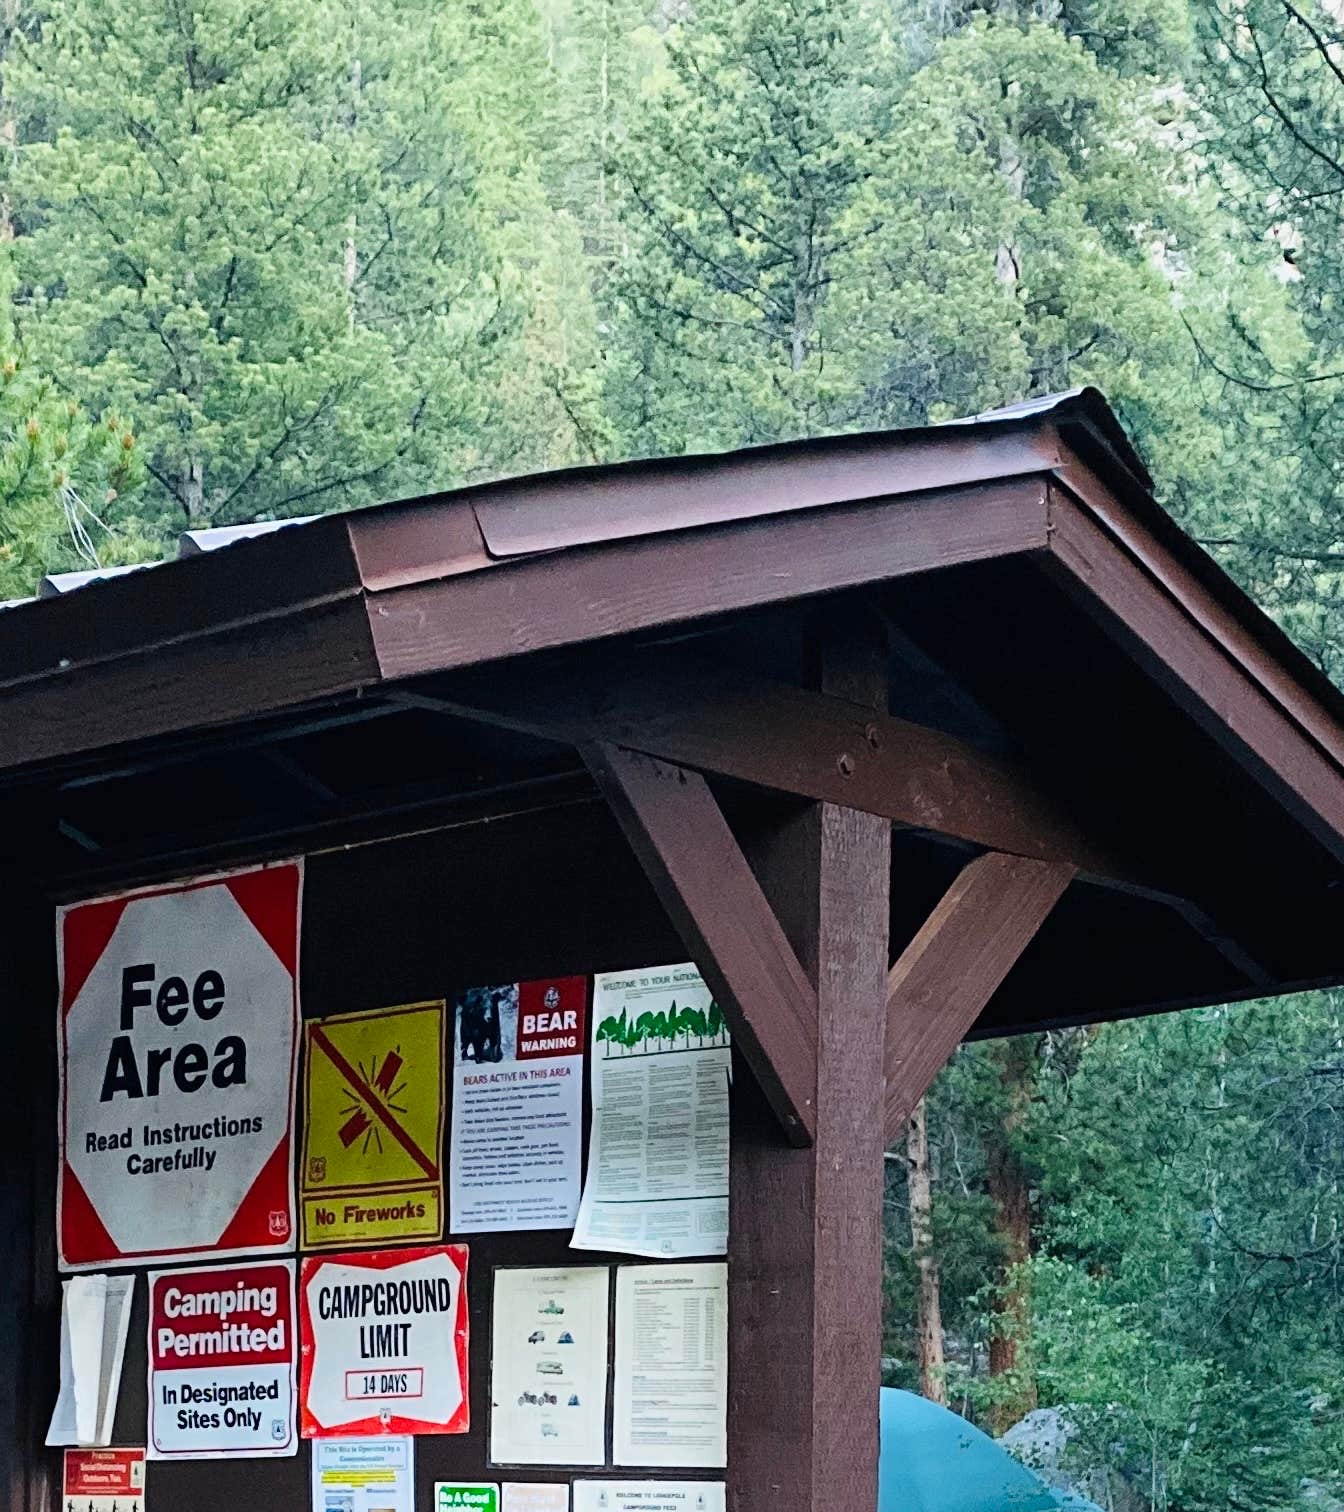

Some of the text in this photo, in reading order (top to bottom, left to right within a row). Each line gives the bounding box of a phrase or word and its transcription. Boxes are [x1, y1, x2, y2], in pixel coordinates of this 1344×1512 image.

[120, 963, 225, 1030] Fee
[523, 1010, 577, 1034] BEAR
[521, 1036, 576, 1052] WARNING
[100, 1036, 246, 1102] Area
[463, 1066, 571, 1086] BEARS ACTIVE IN THIS AREA
[86, 1116, 263, 1153] Read Instructions
[127, 1147, 216, 1176] Carefully
[316, 1200, 425, 1226] No Fireworks
[164, 1282, 277, 1320] Camping
[319, 1278, 451, 1320] CAMPGROUND
[158, 1320, 285, 1358] Permitted
[360, 1323, 411, 1359] LIMIT
[163, 1379, 278, 1406] In Designated
[363, 1374, 407, 1394] 14 DAYS
[177, 1407, 261, 1430] Sites Only
